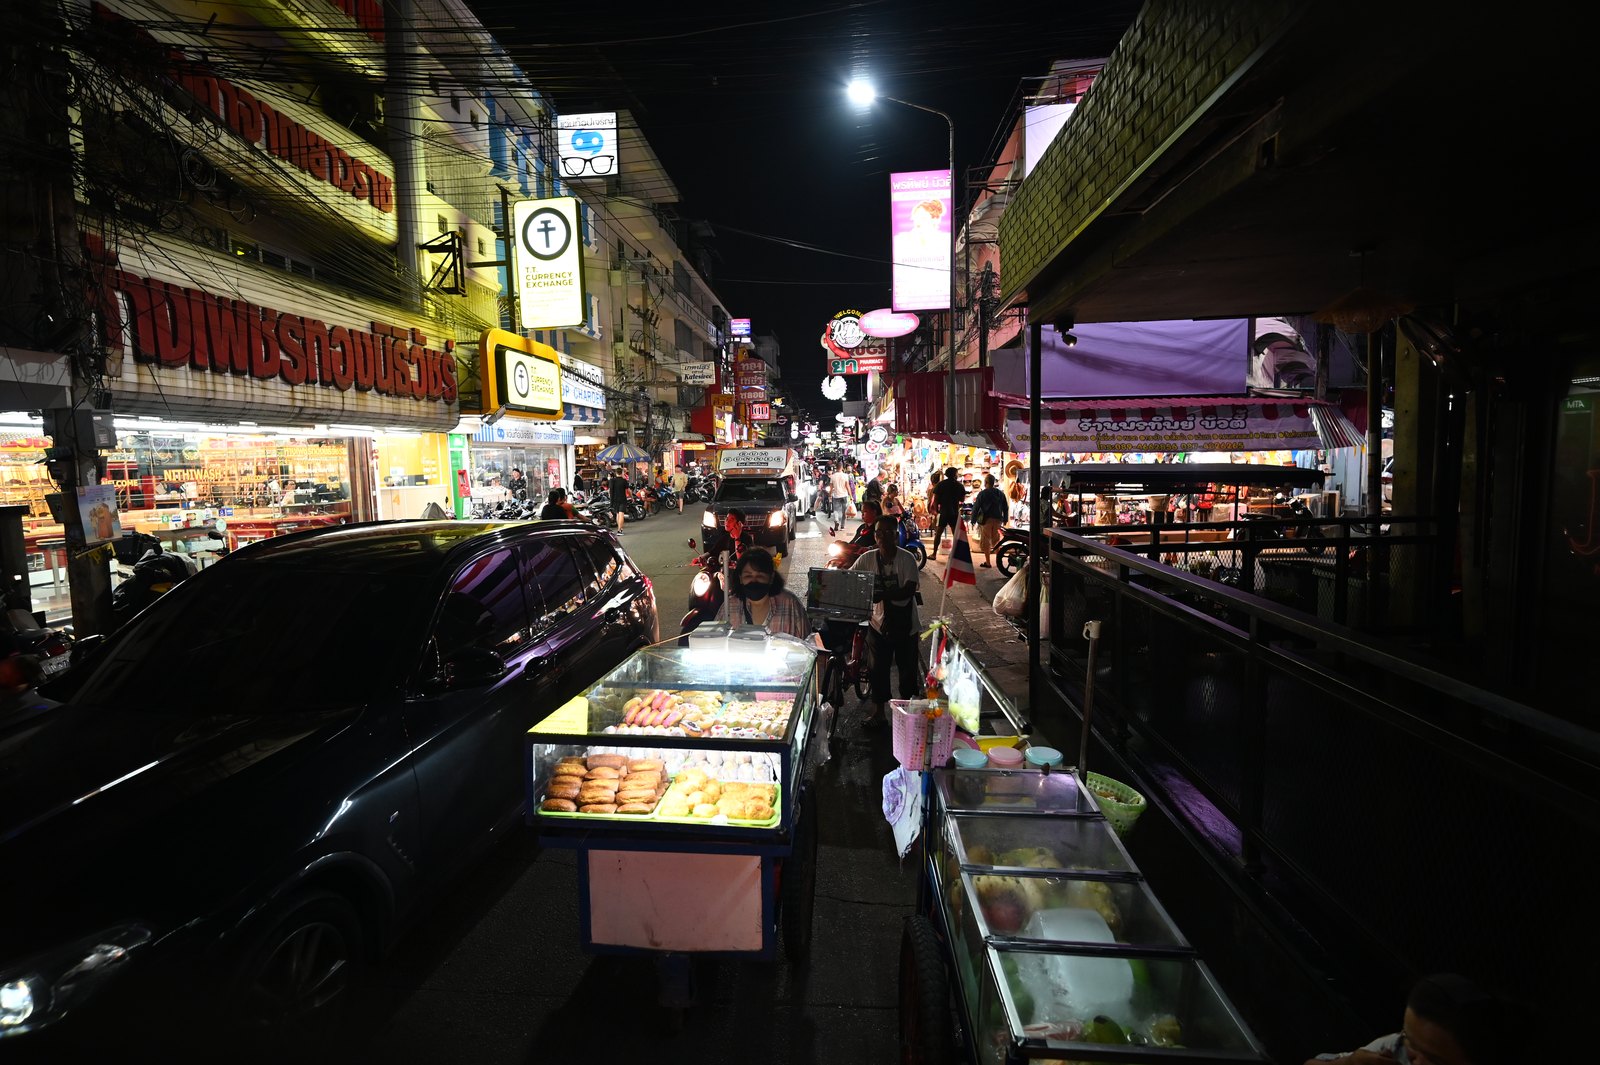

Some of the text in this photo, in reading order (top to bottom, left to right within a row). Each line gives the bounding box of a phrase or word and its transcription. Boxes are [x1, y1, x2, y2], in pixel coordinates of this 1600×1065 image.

[526, 272, 573, 281] CURRENCY
[526, 279, 574, 288] EXCHANGE
[831, 359, 858, 374] ยา
